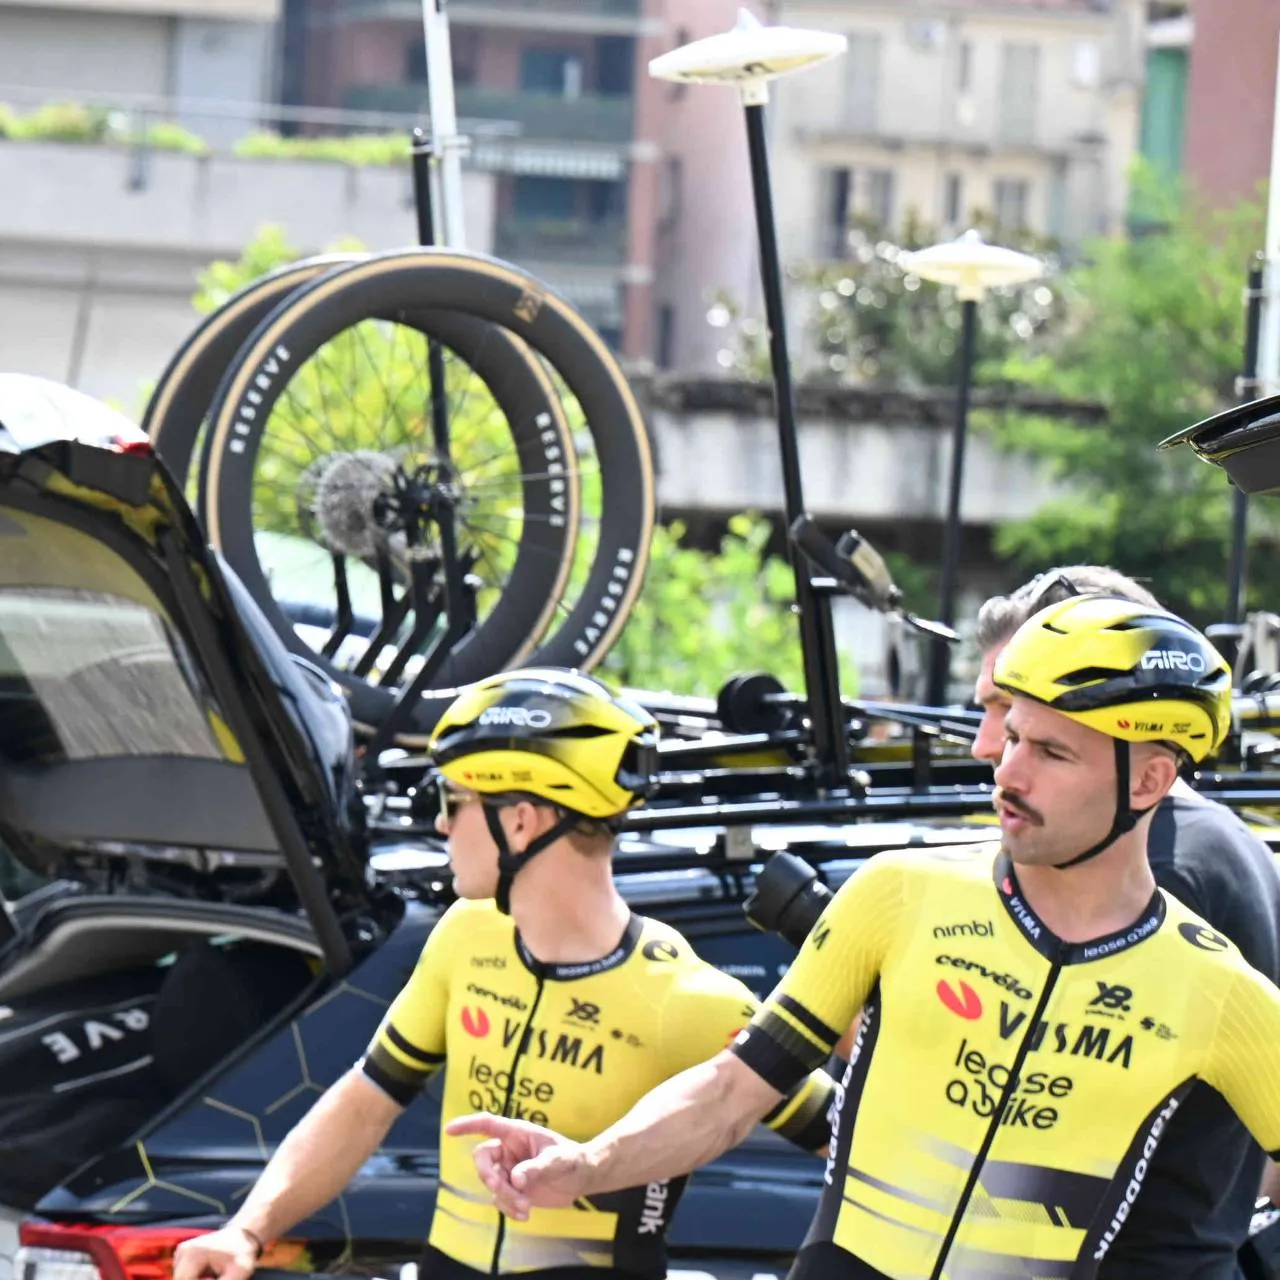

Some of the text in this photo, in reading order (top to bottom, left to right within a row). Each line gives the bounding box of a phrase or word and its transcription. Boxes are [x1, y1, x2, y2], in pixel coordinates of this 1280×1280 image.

[229, 344, 291, 455] RESERVE
[574, 548, 634, 657] RESERVE
[1140, 650, 1204, 672] GIRO
[932, 920, 994, 940] nimbl
[1010, 896, 1041, 940] VISMA
[503, 1017, 604, 1075] VISMA
[999, 1001, 1135, 1070] VISMA
[468, 1055, 554, 1104] lease
[955, 1039, 1074, 1098] lease
[1094, 1096, 1180, 1261] Rabobank
